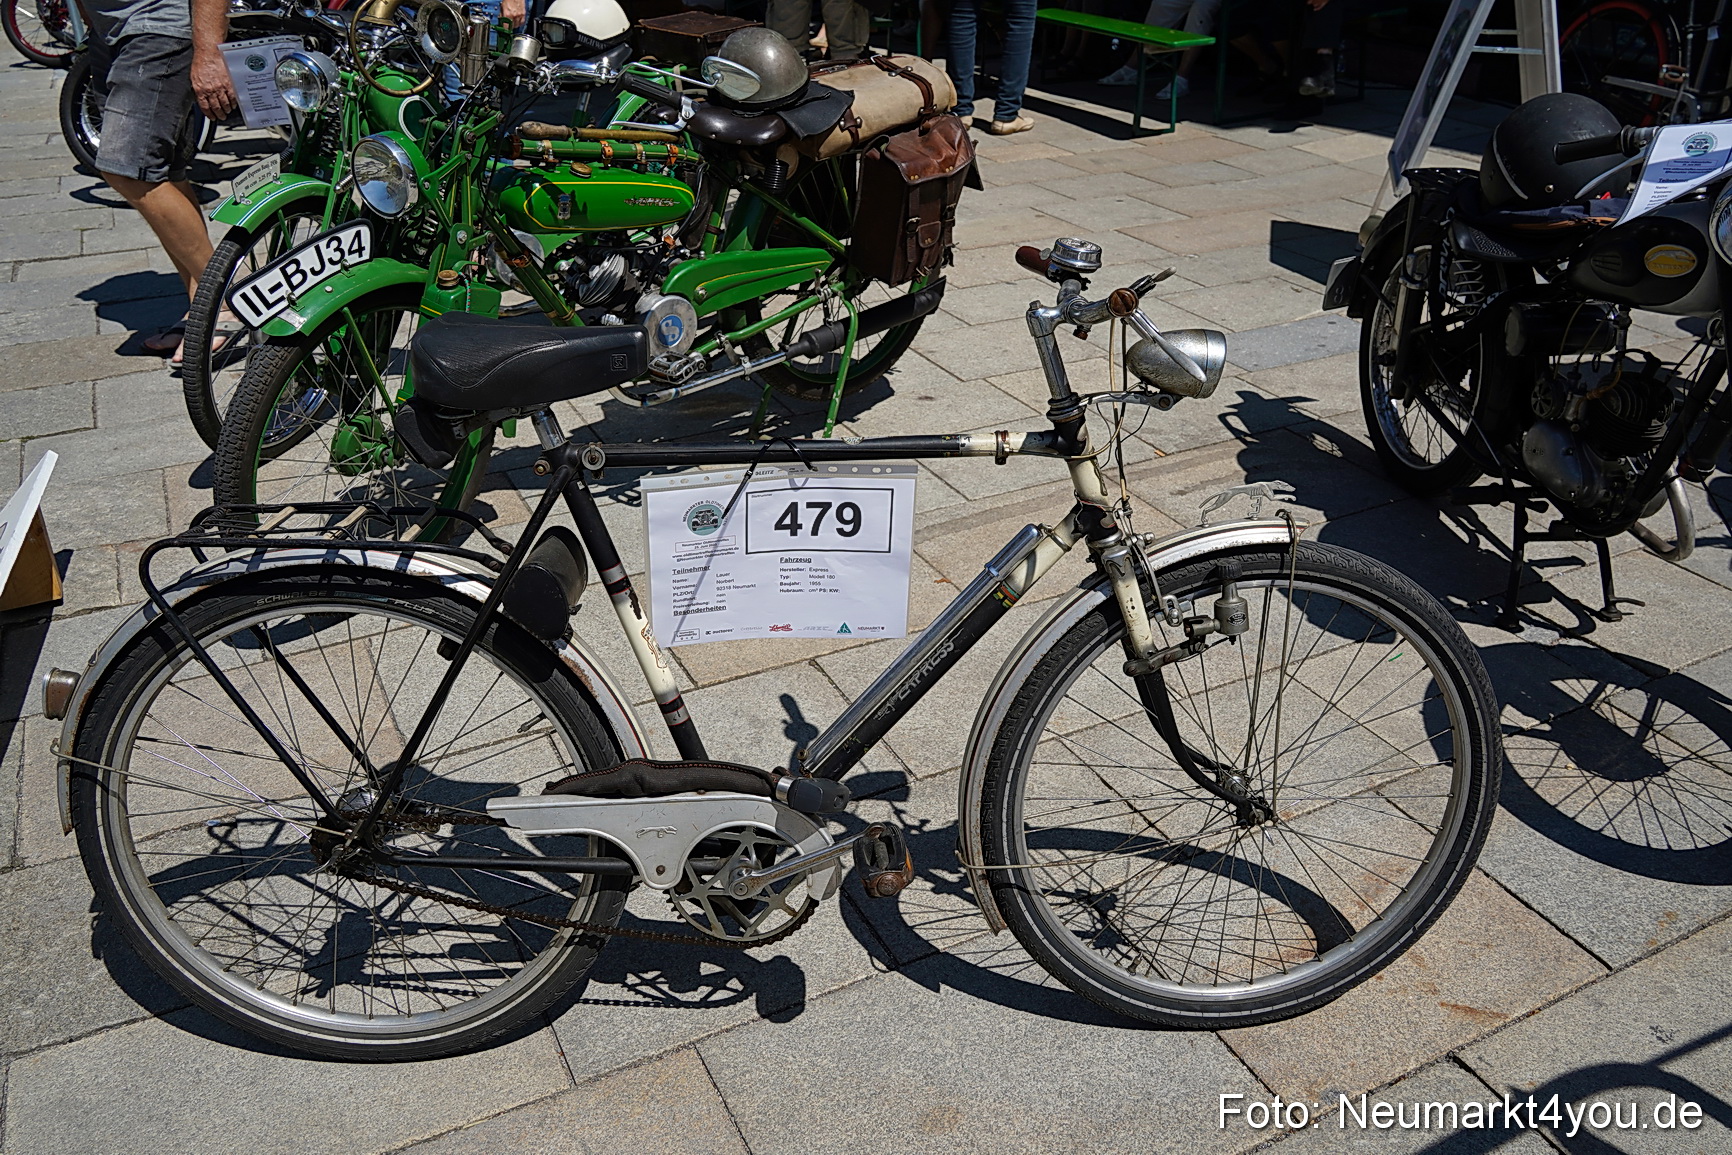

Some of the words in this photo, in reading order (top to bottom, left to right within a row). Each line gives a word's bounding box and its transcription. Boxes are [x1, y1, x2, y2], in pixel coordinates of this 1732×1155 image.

[774, 502, 862, 538] 479
[672, 565, 711, 575] Teilnehmer
[255, 590, 328, 607] SCHWALBE
[673, 605, 727, 616] Besonderheiten
[898, 636, 956, 702] EXPRESS
